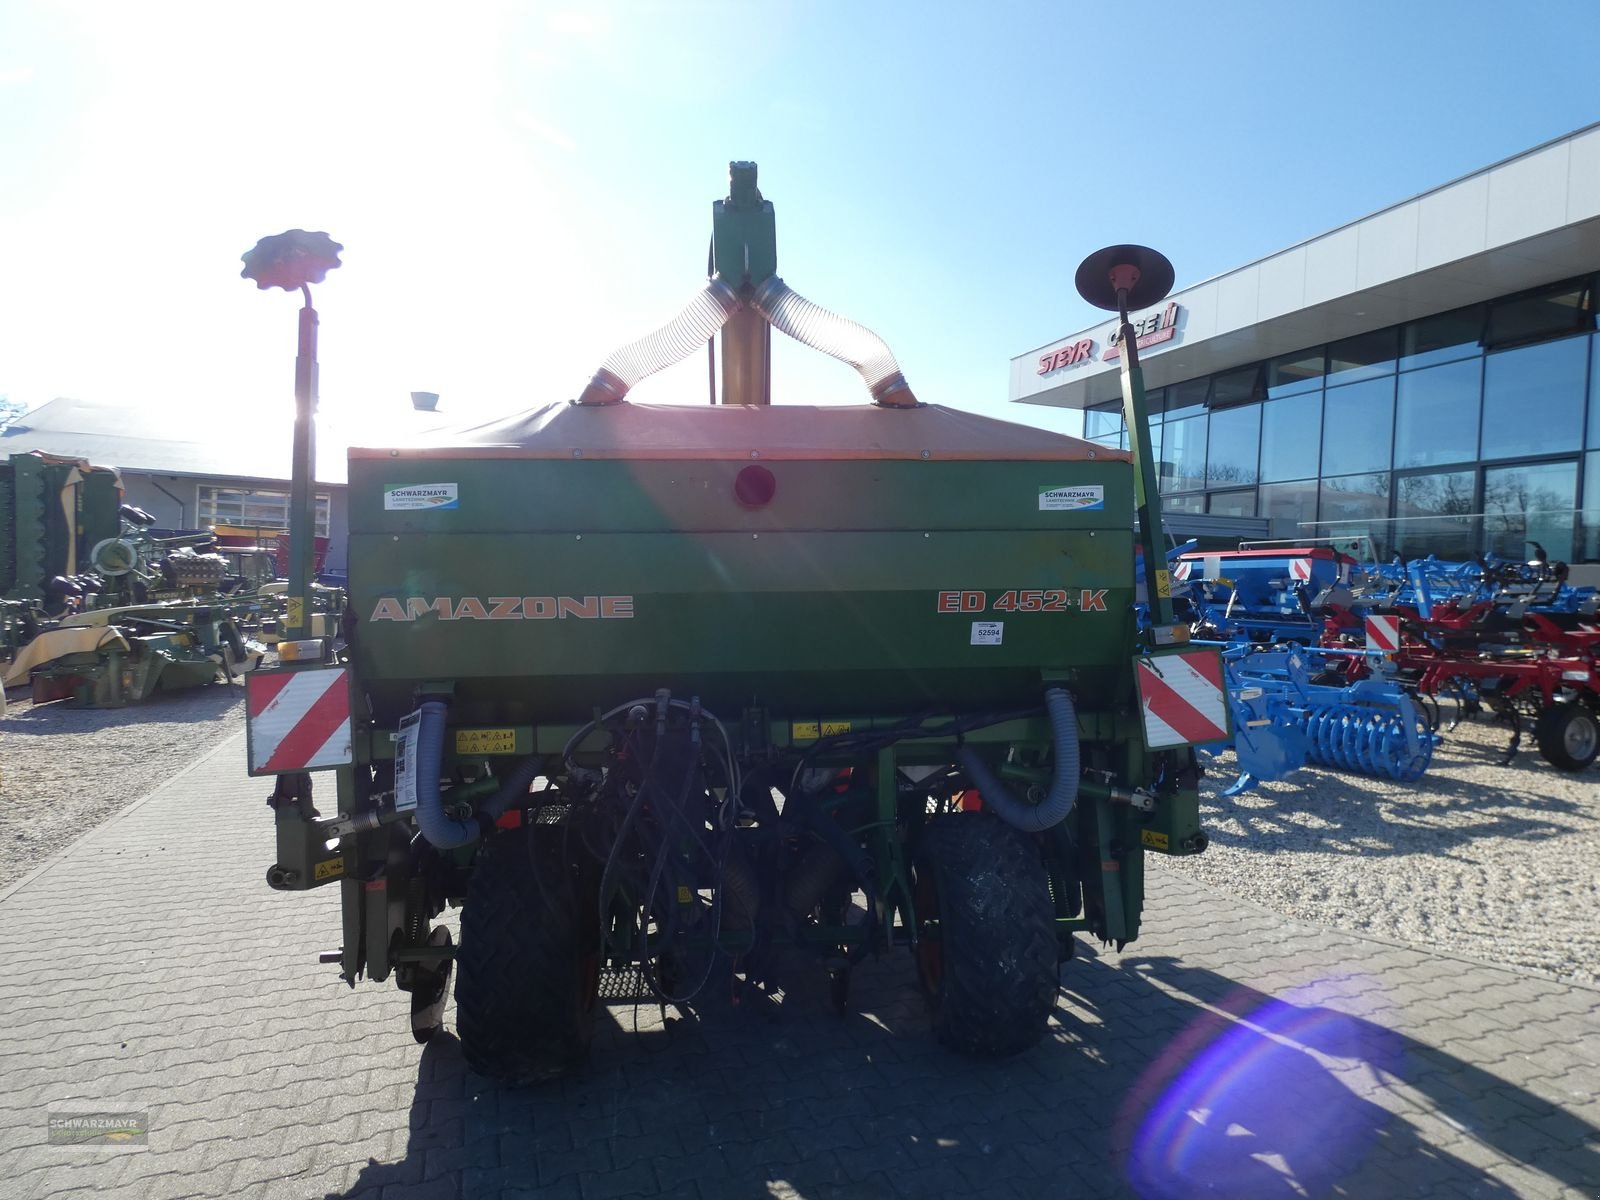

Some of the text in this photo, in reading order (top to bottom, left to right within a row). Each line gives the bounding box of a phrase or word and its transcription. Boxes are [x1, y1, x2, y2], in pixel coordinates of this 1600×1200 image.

[1107, 314, 1160, 347] CSE
[1037, 338, 1092, 375] STEYR
[369, 595, 634, 622] AMAZONE
[937, 590, 986, 613] ED
